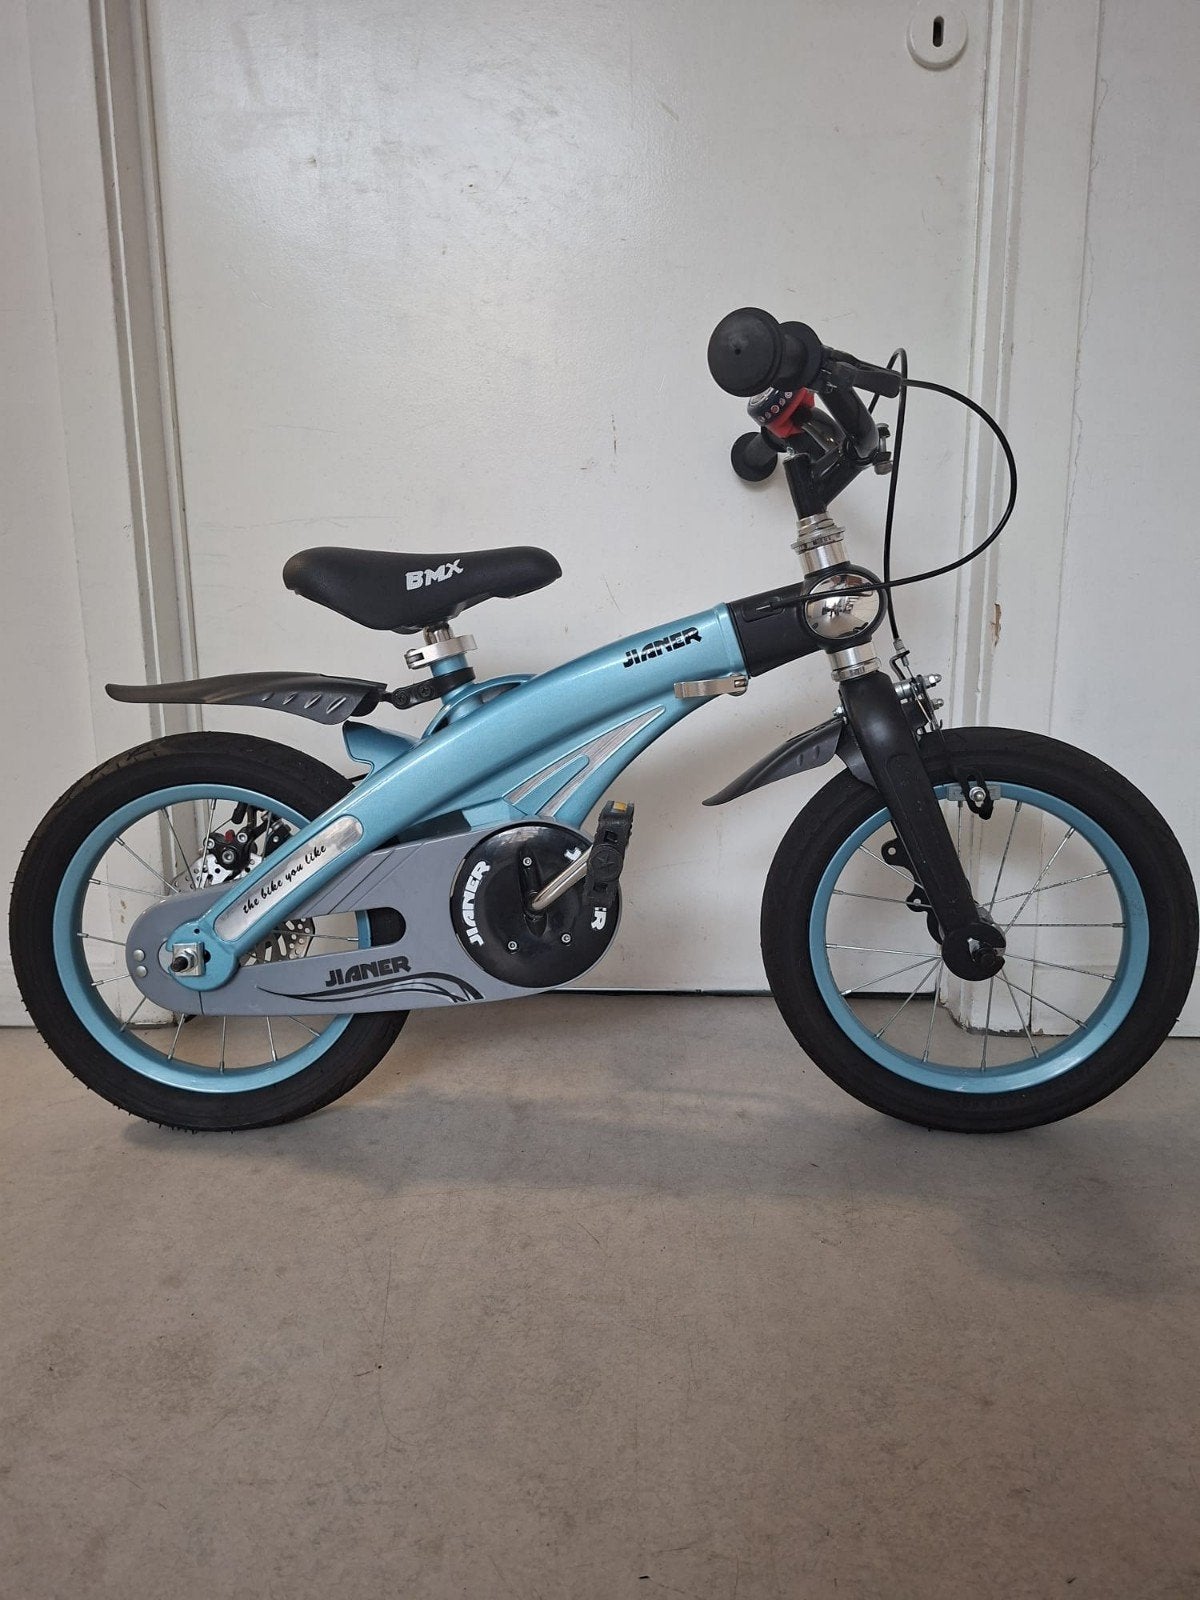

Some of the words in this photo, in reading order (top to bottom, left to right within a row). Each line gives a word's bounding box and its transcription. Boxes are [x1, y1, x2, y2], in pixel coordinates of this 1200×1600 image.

[405, 559, 463, 591] BMX
[623, 627, 702, 668] JIANER
[243, 898, 259, 914] the
[260, 880, 282, 899] bike
[285, 864, 303, 882] you
[304, 845, 326, 864] like
[462, 861, 491, 947] JIANER
[325, 956, 411, 987] JIANER
